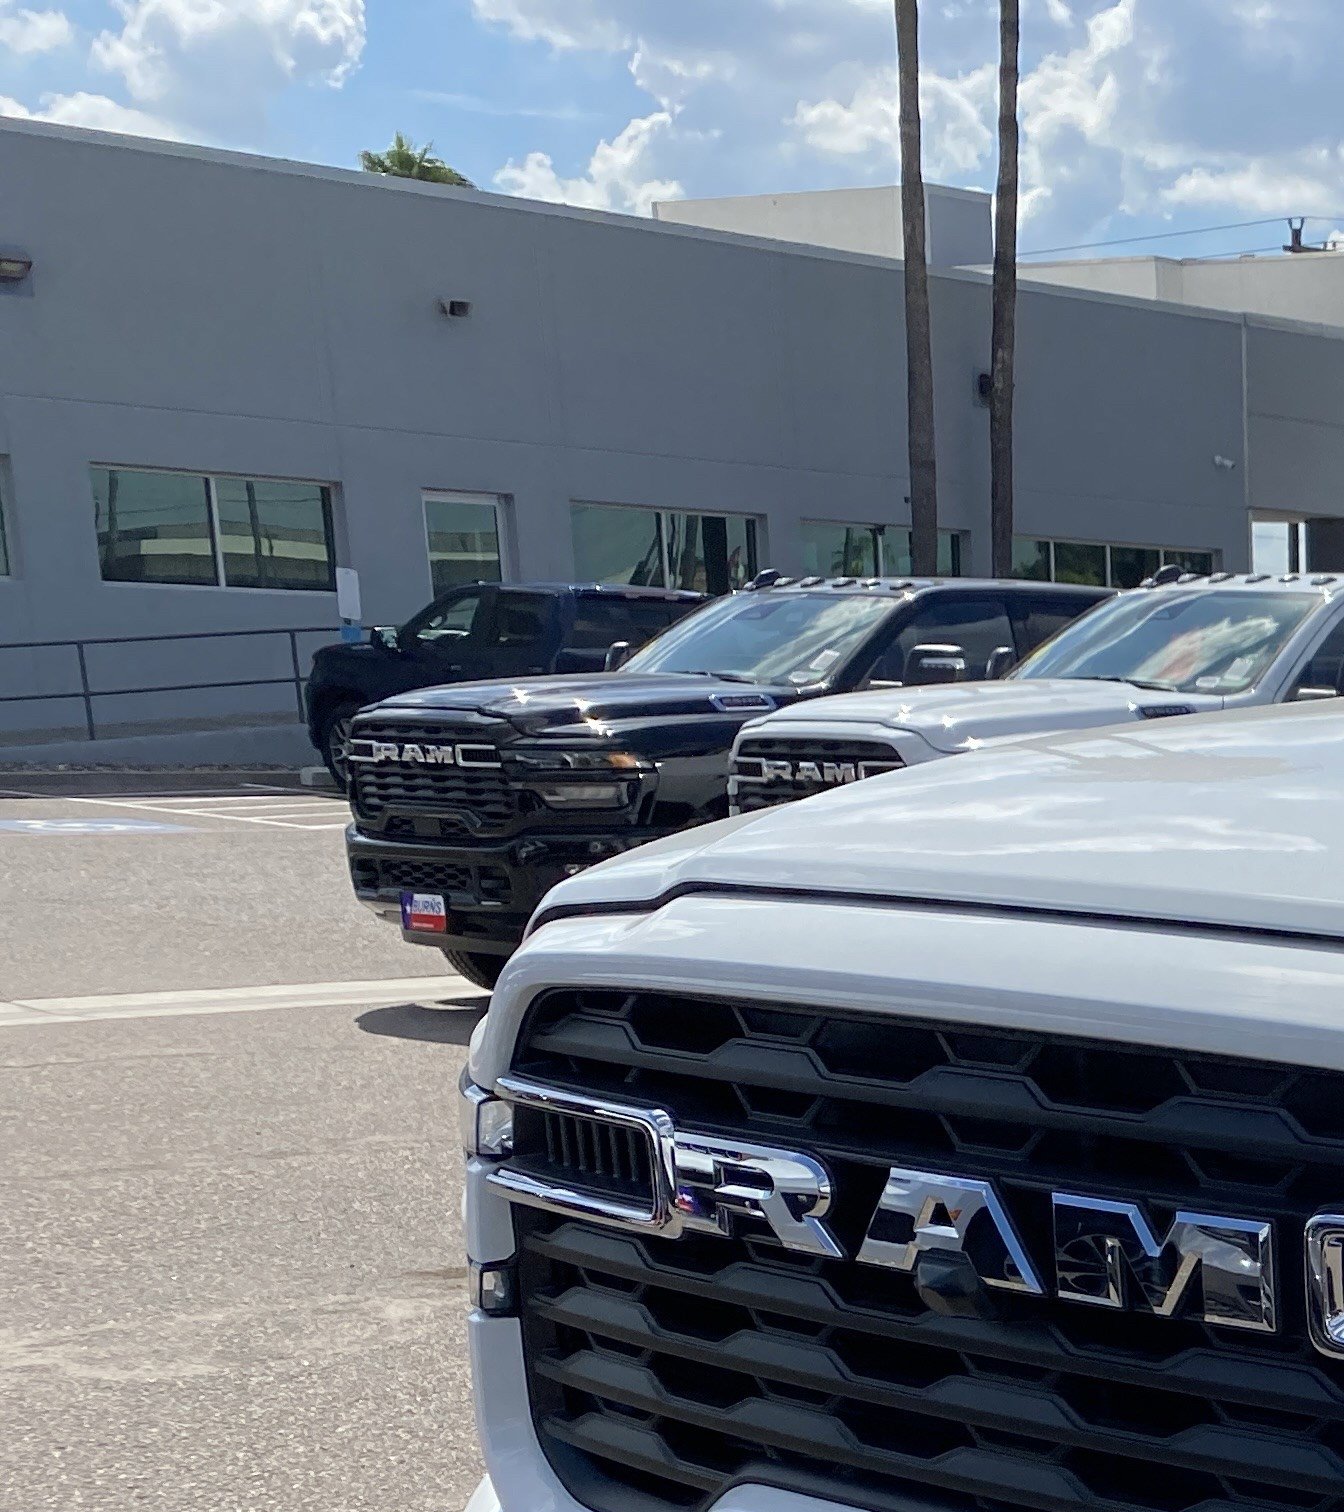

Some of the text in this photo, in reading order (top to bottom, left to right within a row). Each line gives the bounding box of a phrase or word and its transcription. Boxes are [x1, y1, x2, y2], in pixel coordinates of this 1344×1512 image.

[372, 742, 456, 765] RAM
[763, 759, 857, 784] RAM
[671, 1130, 1279, 1335] RAM
